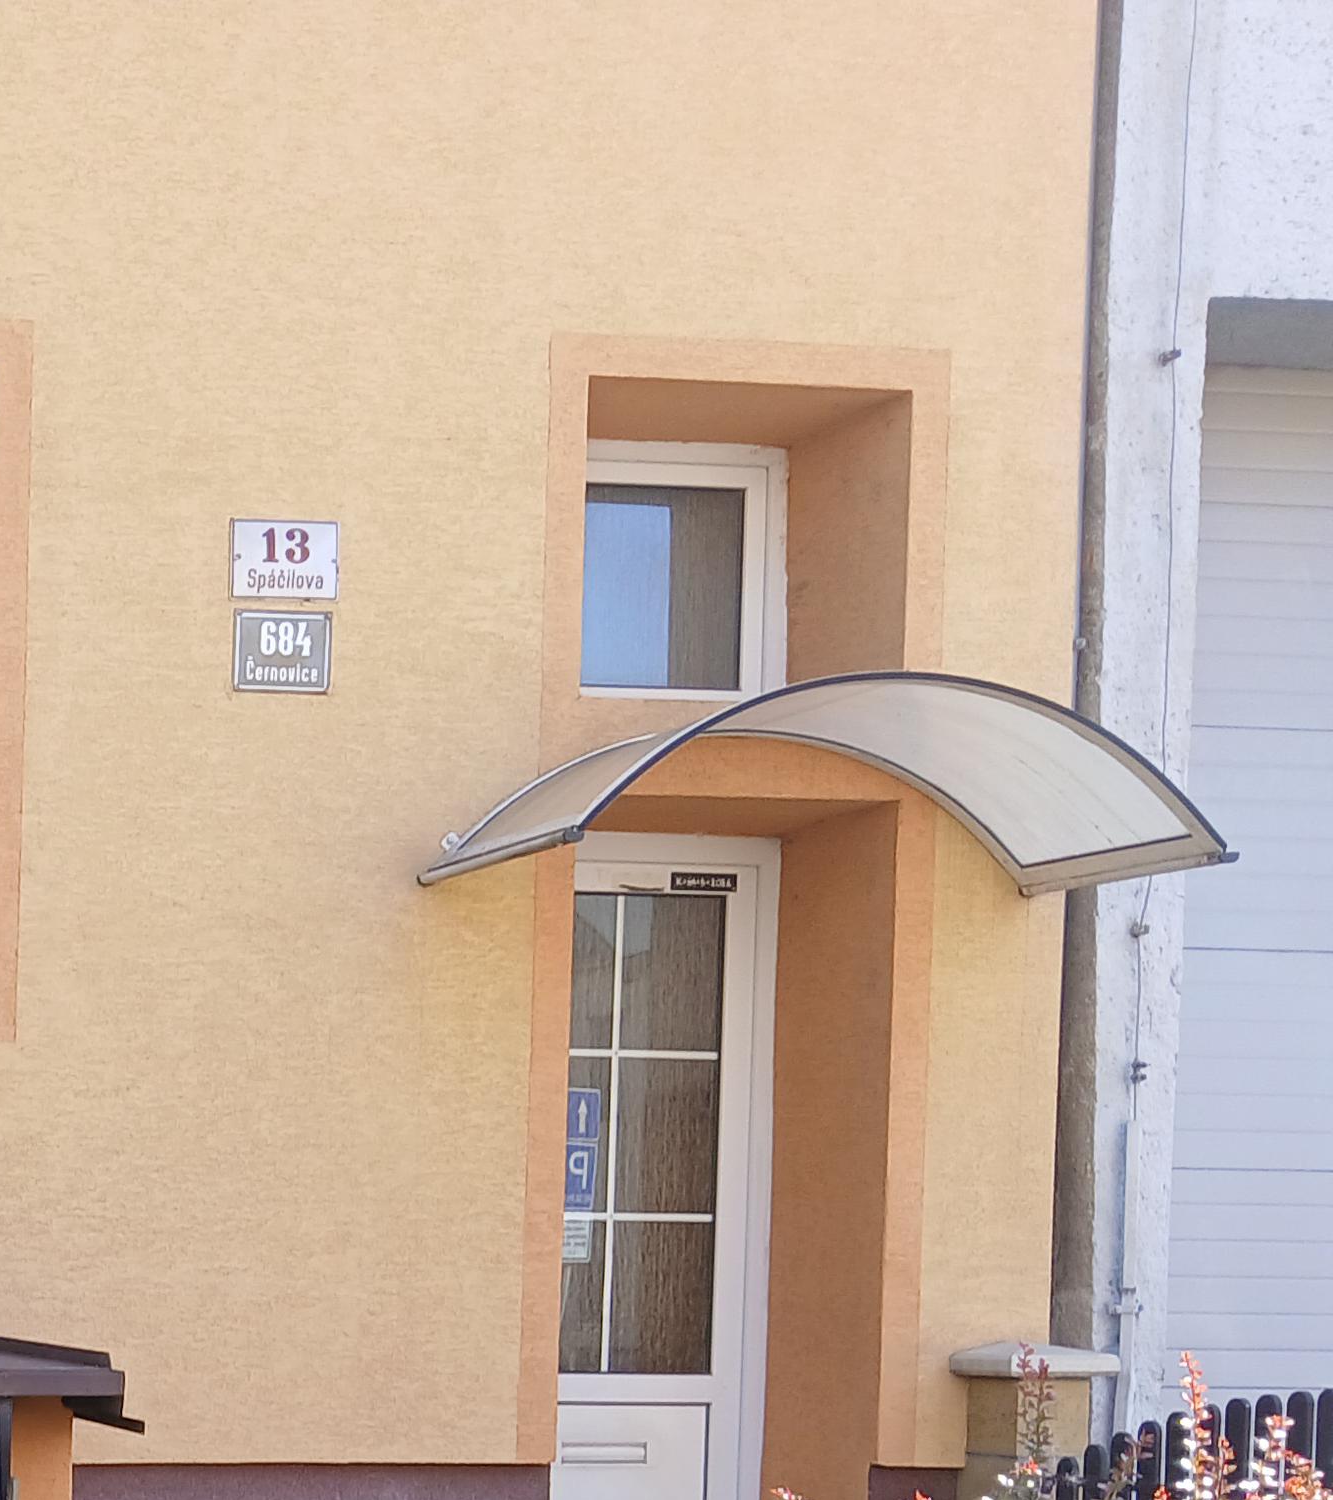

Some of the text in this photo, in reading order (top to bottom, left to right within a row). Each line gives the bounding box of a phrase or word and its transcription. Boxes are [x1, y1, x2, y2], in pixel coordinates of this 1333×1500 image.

[261, 526, 311, 564] 13
[246, 568, 325, 594] Spáčilova
[259, 620, 313, 658] 684
[245, 655, 319, 683] Černovice
